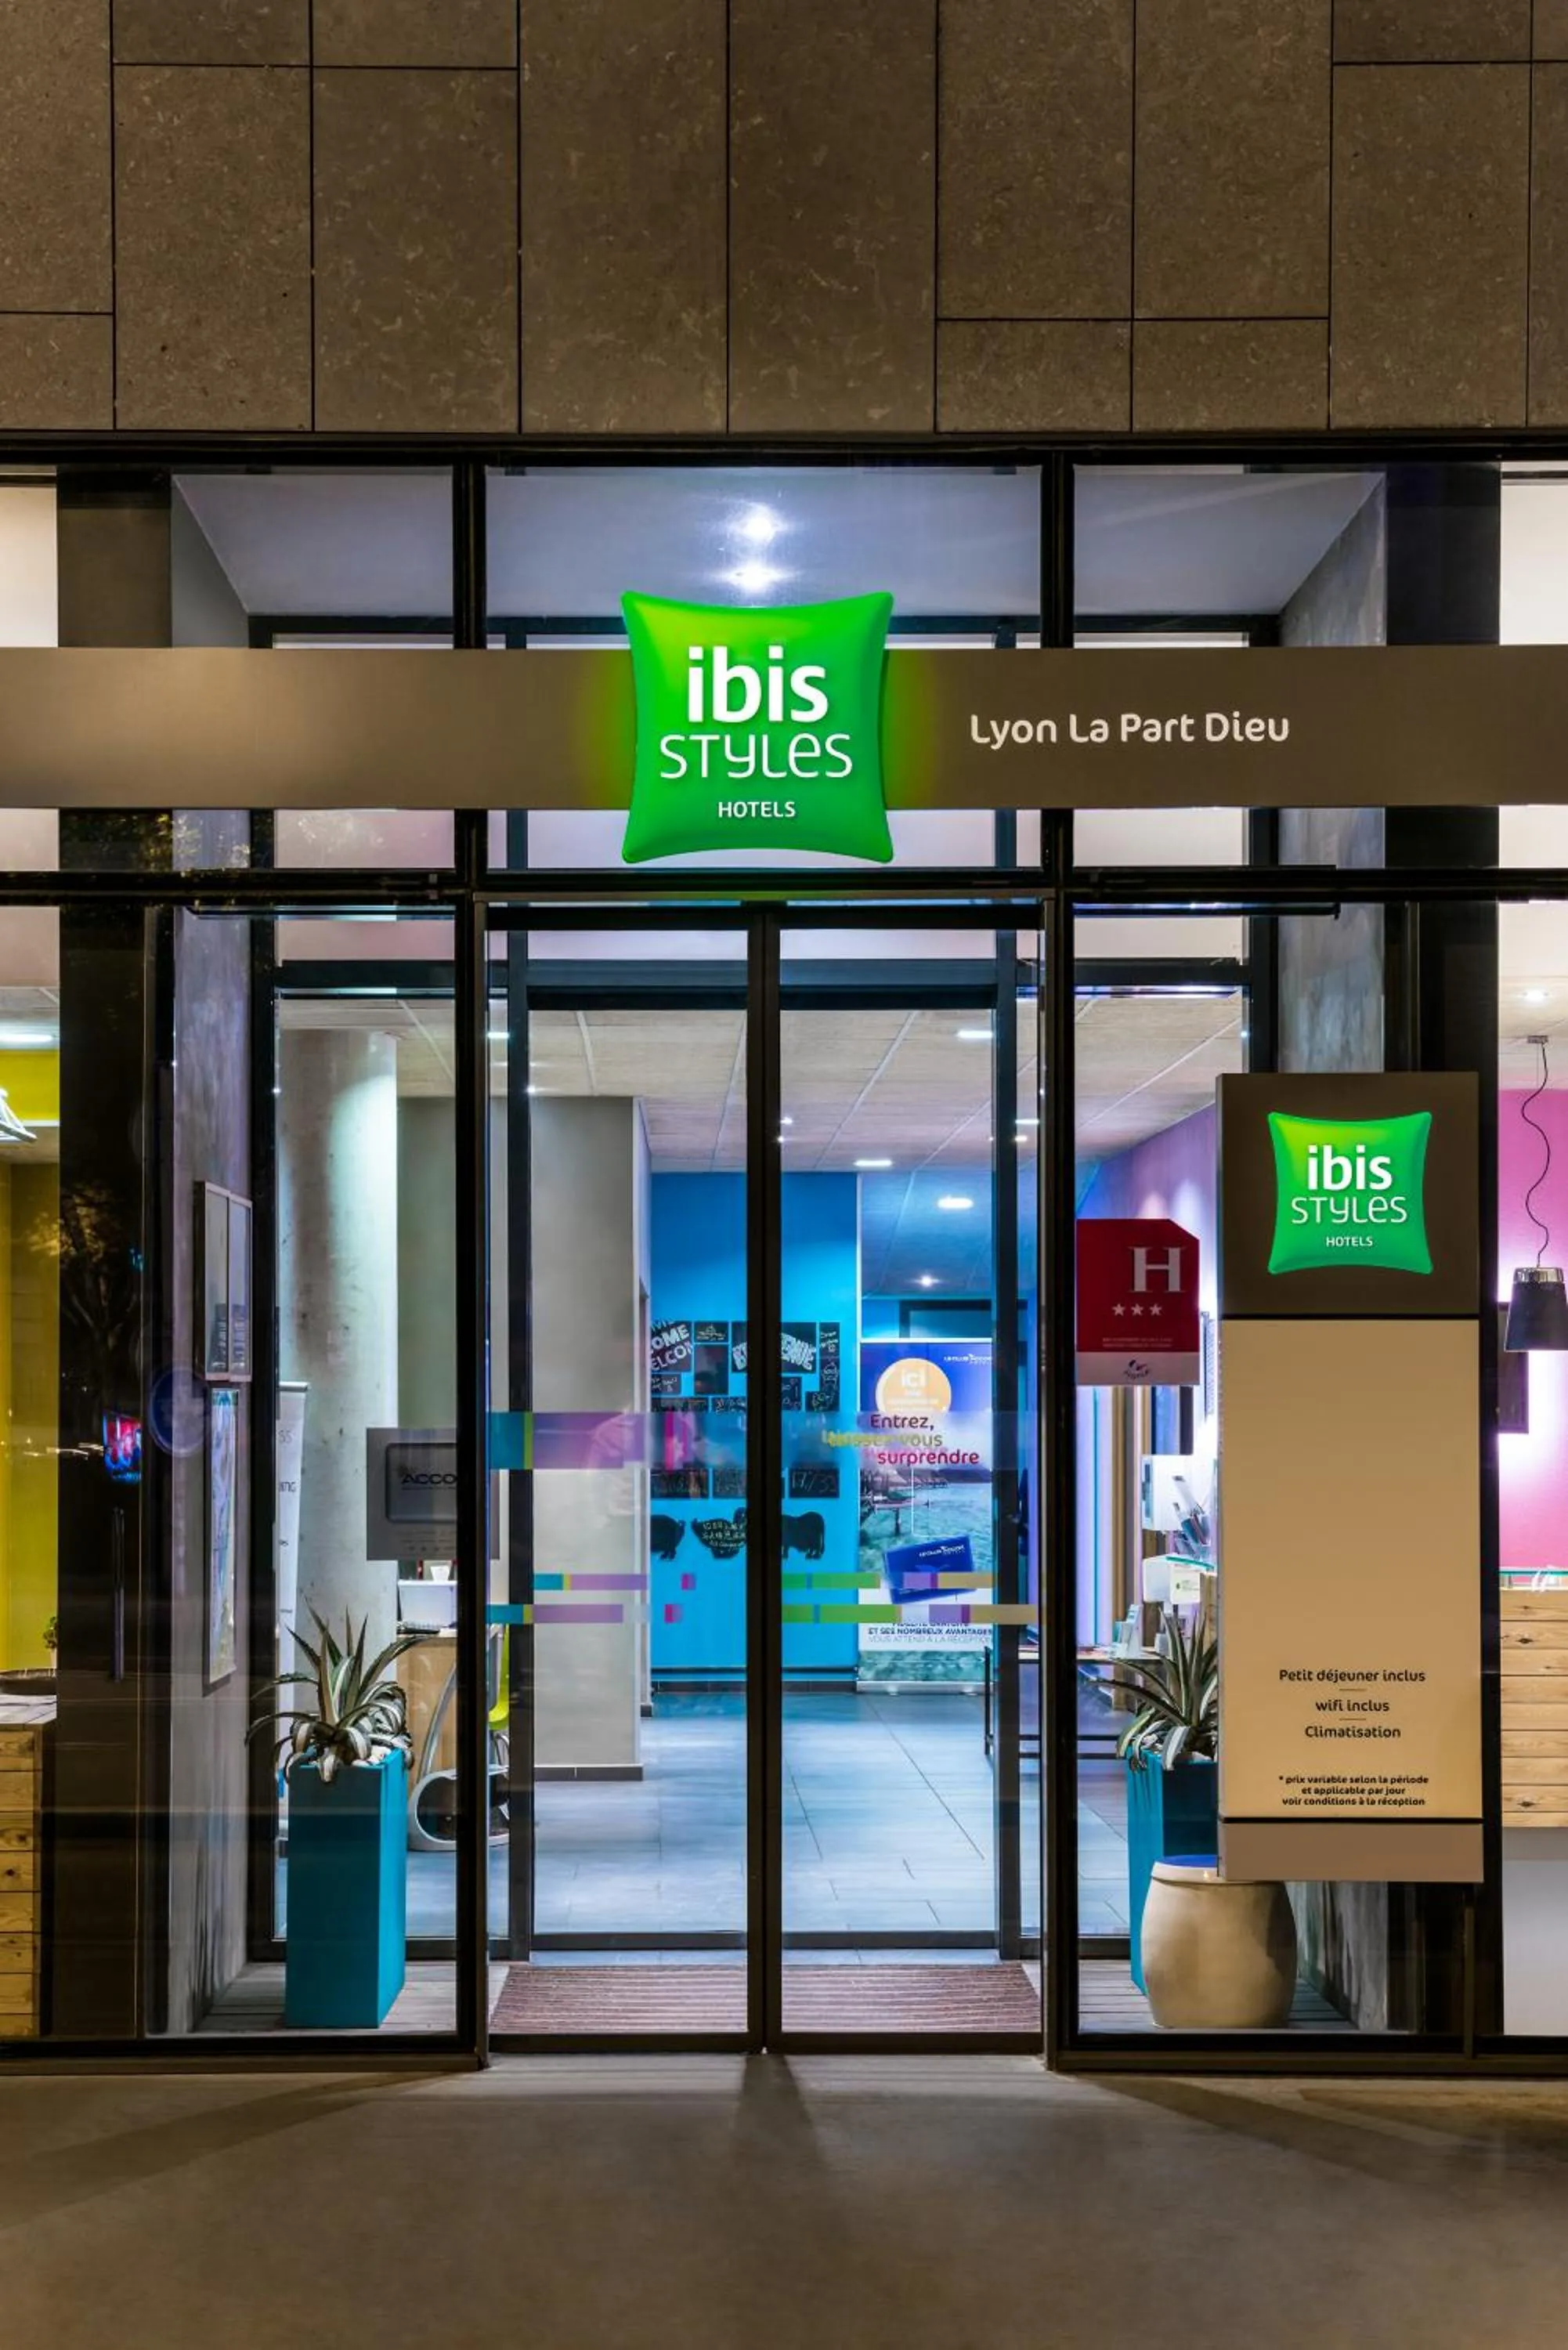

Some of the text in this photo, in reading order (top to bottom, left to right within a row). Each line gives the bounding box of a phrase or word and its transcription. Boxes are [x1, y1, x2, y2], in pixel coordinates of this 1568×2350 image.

[688, 645, 829, 724] ibis
[971, 710, 1290, 750] Lyon La Part Dieu
[718, 801, 796, 818] HOTELS
[1307, 1144, 1393, 1191] ibis
[1326, 1236, 1374, 1247] HOTELS
[1129, 1246, 1184, 1293] H
[870, 1414, 934, 1430] Entrez,
[877, 1448, 980, 1466] surprendre
[402, 1472, 457, 1485] ACCO
[1279, 1668, 1426, 1684] Petit déjeuner inclus
[1315, 1699, 1390, 1712] wifi inclus
[1304, 1725, 1402, 1739] Climatisation
[1285, 1775, 1430, 1786] prix variable selon la période
[1301, 1785, 1407, 1797] et applicable par jour
[1282, 1795, 1426, 1809] voir conditions à la réception
